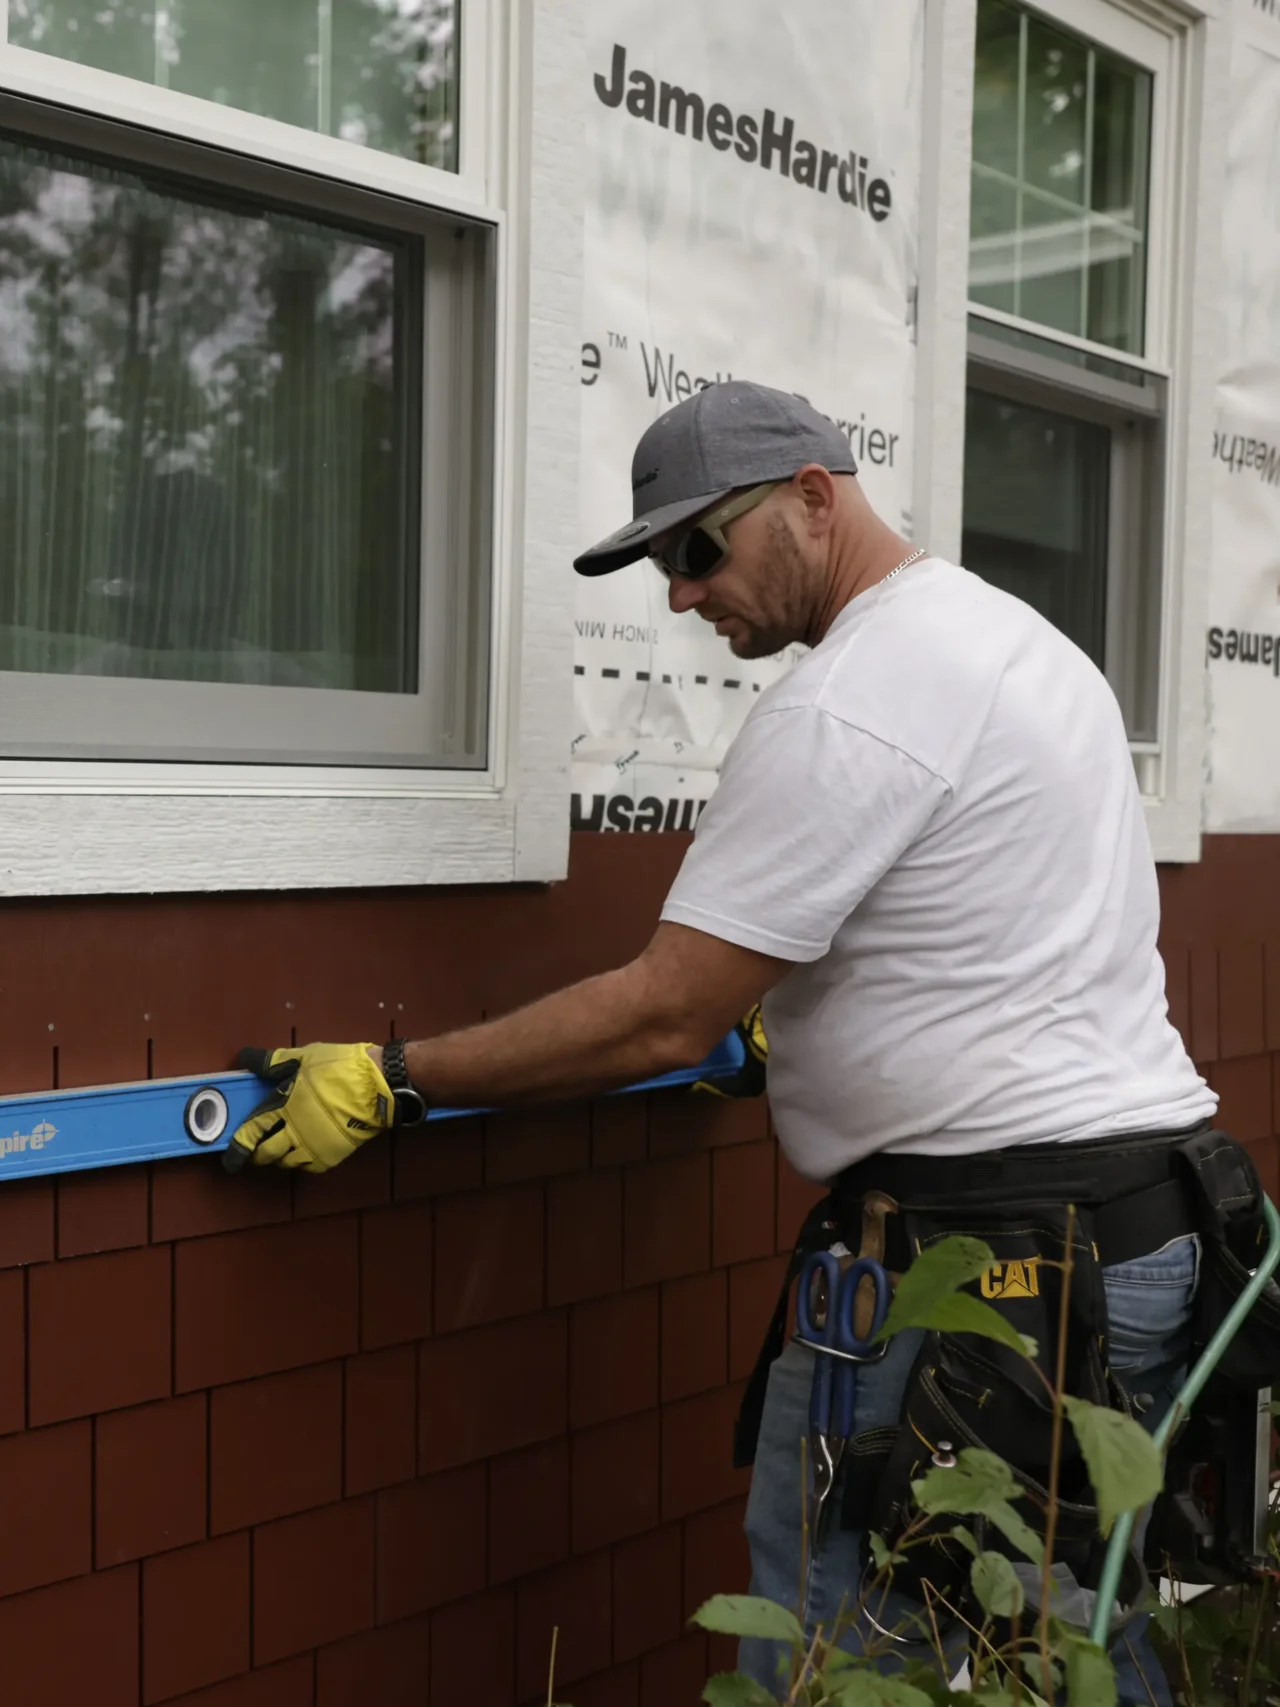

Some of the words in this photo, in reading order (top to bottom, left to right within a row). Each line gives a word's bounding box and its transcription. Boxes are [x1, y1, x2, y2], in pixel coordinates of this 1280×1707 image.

[594, 43, 892, 222] JamesHardie
[1213, 430, 1280, 487] Weath
[613, 624, 650, 644] INCH
[981, 1256, 1040, 1299] CAT
